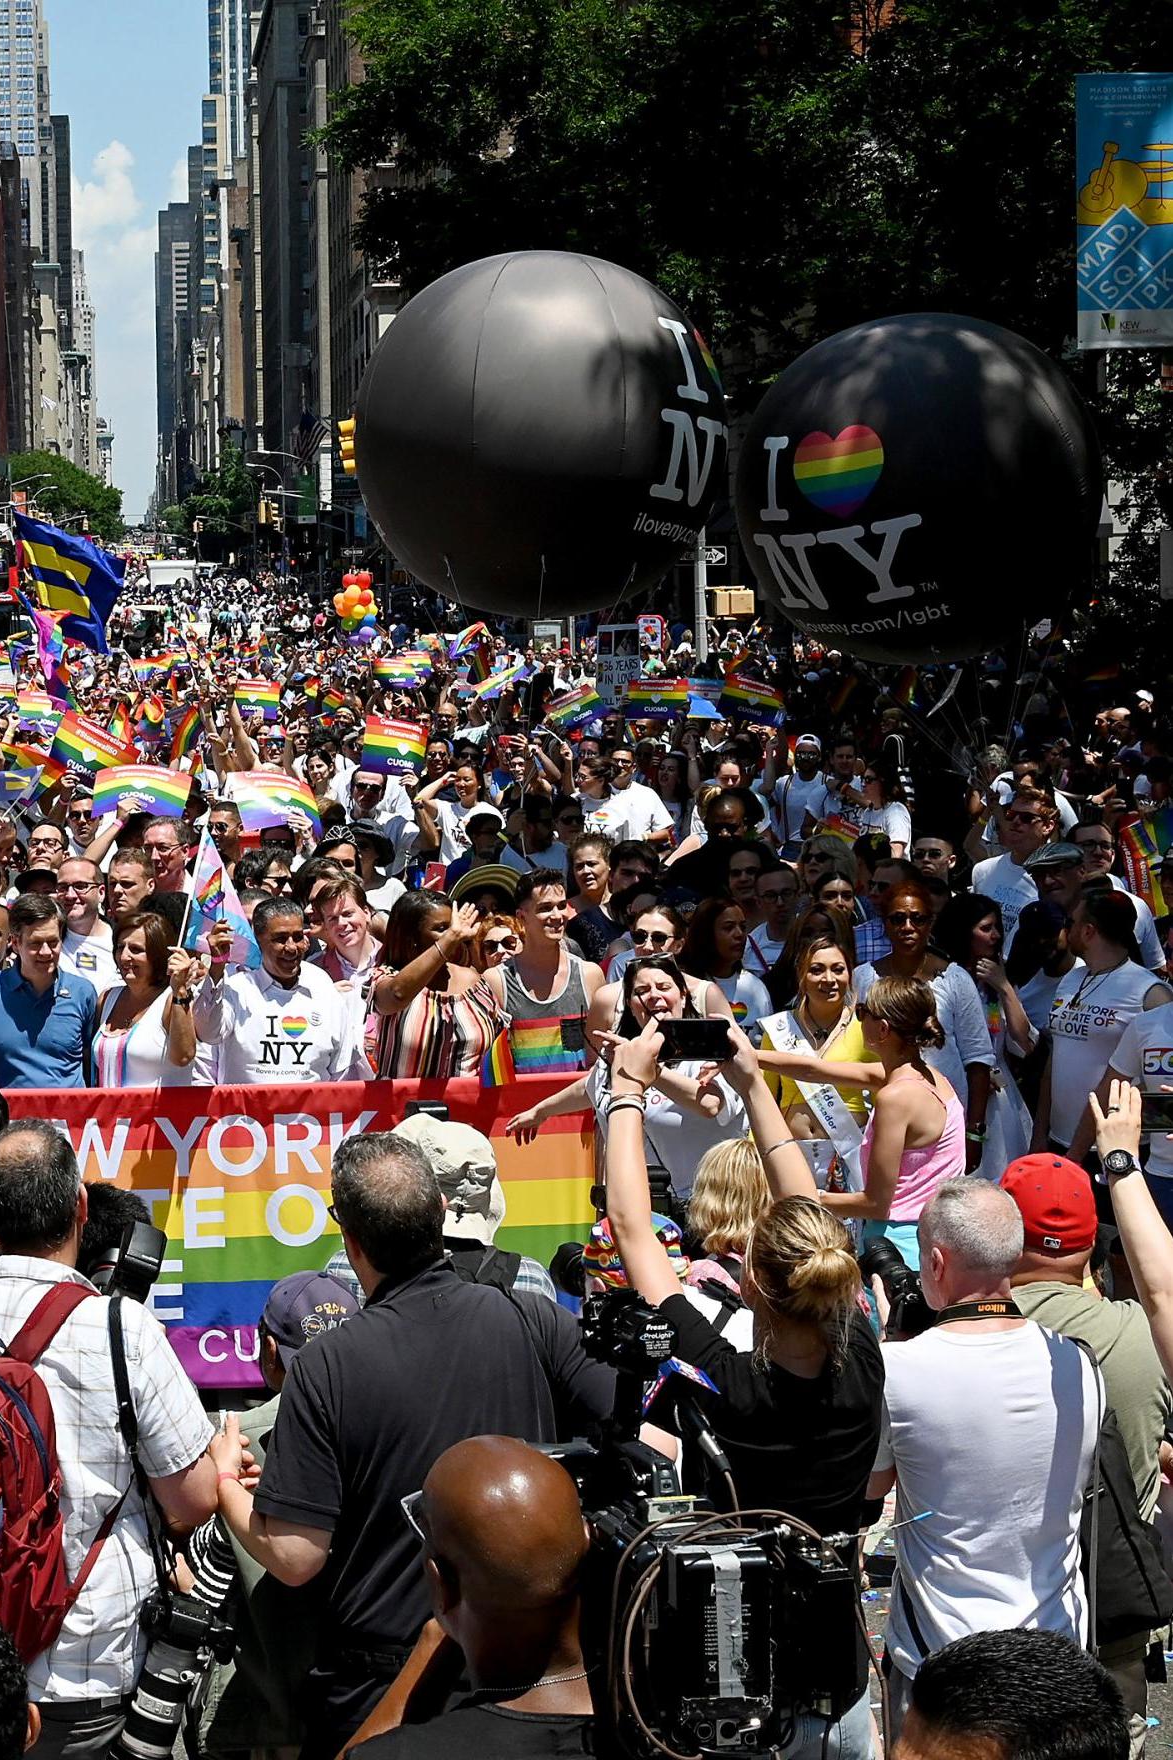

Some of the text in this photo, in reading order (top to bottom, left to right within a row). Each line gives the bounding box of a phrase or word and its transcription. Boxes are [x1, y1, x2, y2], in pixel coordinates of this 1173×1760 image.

[1077, 223, 1136, 278] MAD.
[658, 316, 709, 404] I
[649, 408, 727, 507] N
[760, 436, 789, 521] I
[633, 512, 699, 543] iloveny.c
[753, 513, 922, 610] NY
[573, 708, 594, 722] CUOMO
[75, 728, 119, 756] #Stonewall50
[77, 717, 127, 751] Commemorating
[66, 758, 97, 780] CUOMO
[387, 758, 415, 770] CUOMO
[118, 791, 156, 805] CUOMO
[1139, 859, 1150, 894] #Stone
[1060, 1010, 1115, 1028] STATE OF
[1086, 1004, 1119, 1019] YORK
[265, 1015, 279, 1038] I
[1058, 1020, 1089, 1036] LOVE
[258, 1040, 313, 1066] NY
[1144, 1051, 1173, 1073] 50
[265, 1183, 329, 1247] O
[314, 1302, 347, 1314] GONE
[977, 1303, 1006, 1313] Nikon
